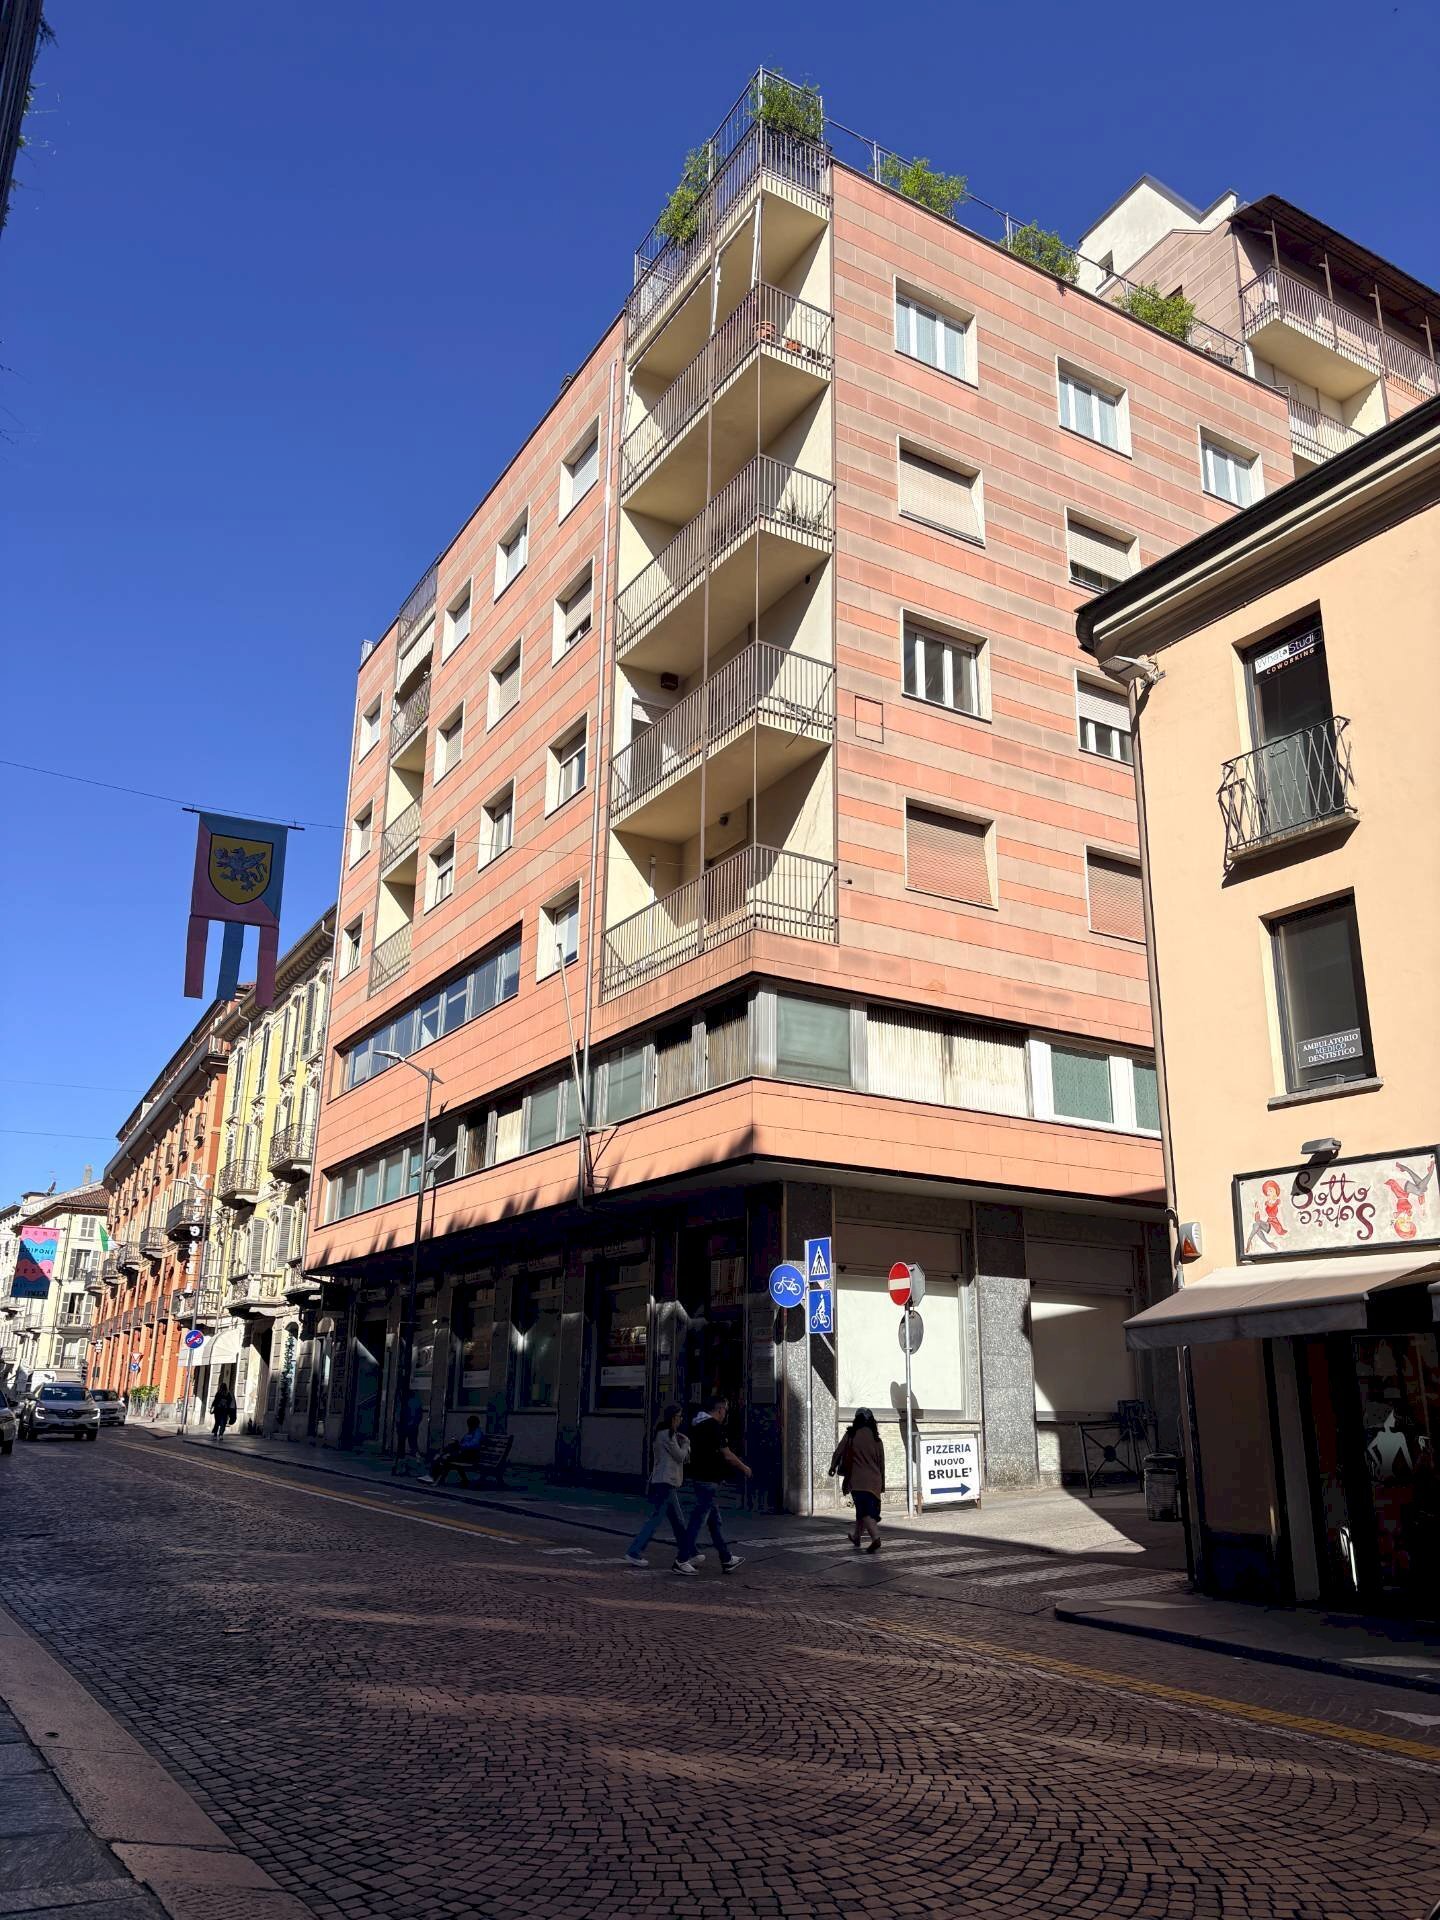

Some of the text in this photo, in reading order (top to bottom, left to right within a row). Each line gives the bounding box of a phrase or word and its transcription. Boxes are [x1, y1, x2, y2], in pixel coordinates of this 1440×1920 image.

[1266, 647, 1315, 675] COWORKING
[1303, 1033, 1359, 1051] AMBULATORIO
[1315, 1042, 1347, 1055] MEDICO
[1308, 1047, 1356, 1063] DENTISTICO
[1291, 1171, 1372, 1210] Sotto
[926, 1443, 971, 1455] PIZZERIA
[934, 1457, 965, 1467] NUOVO
[928, 1467, 972, 1480] BRULE'
